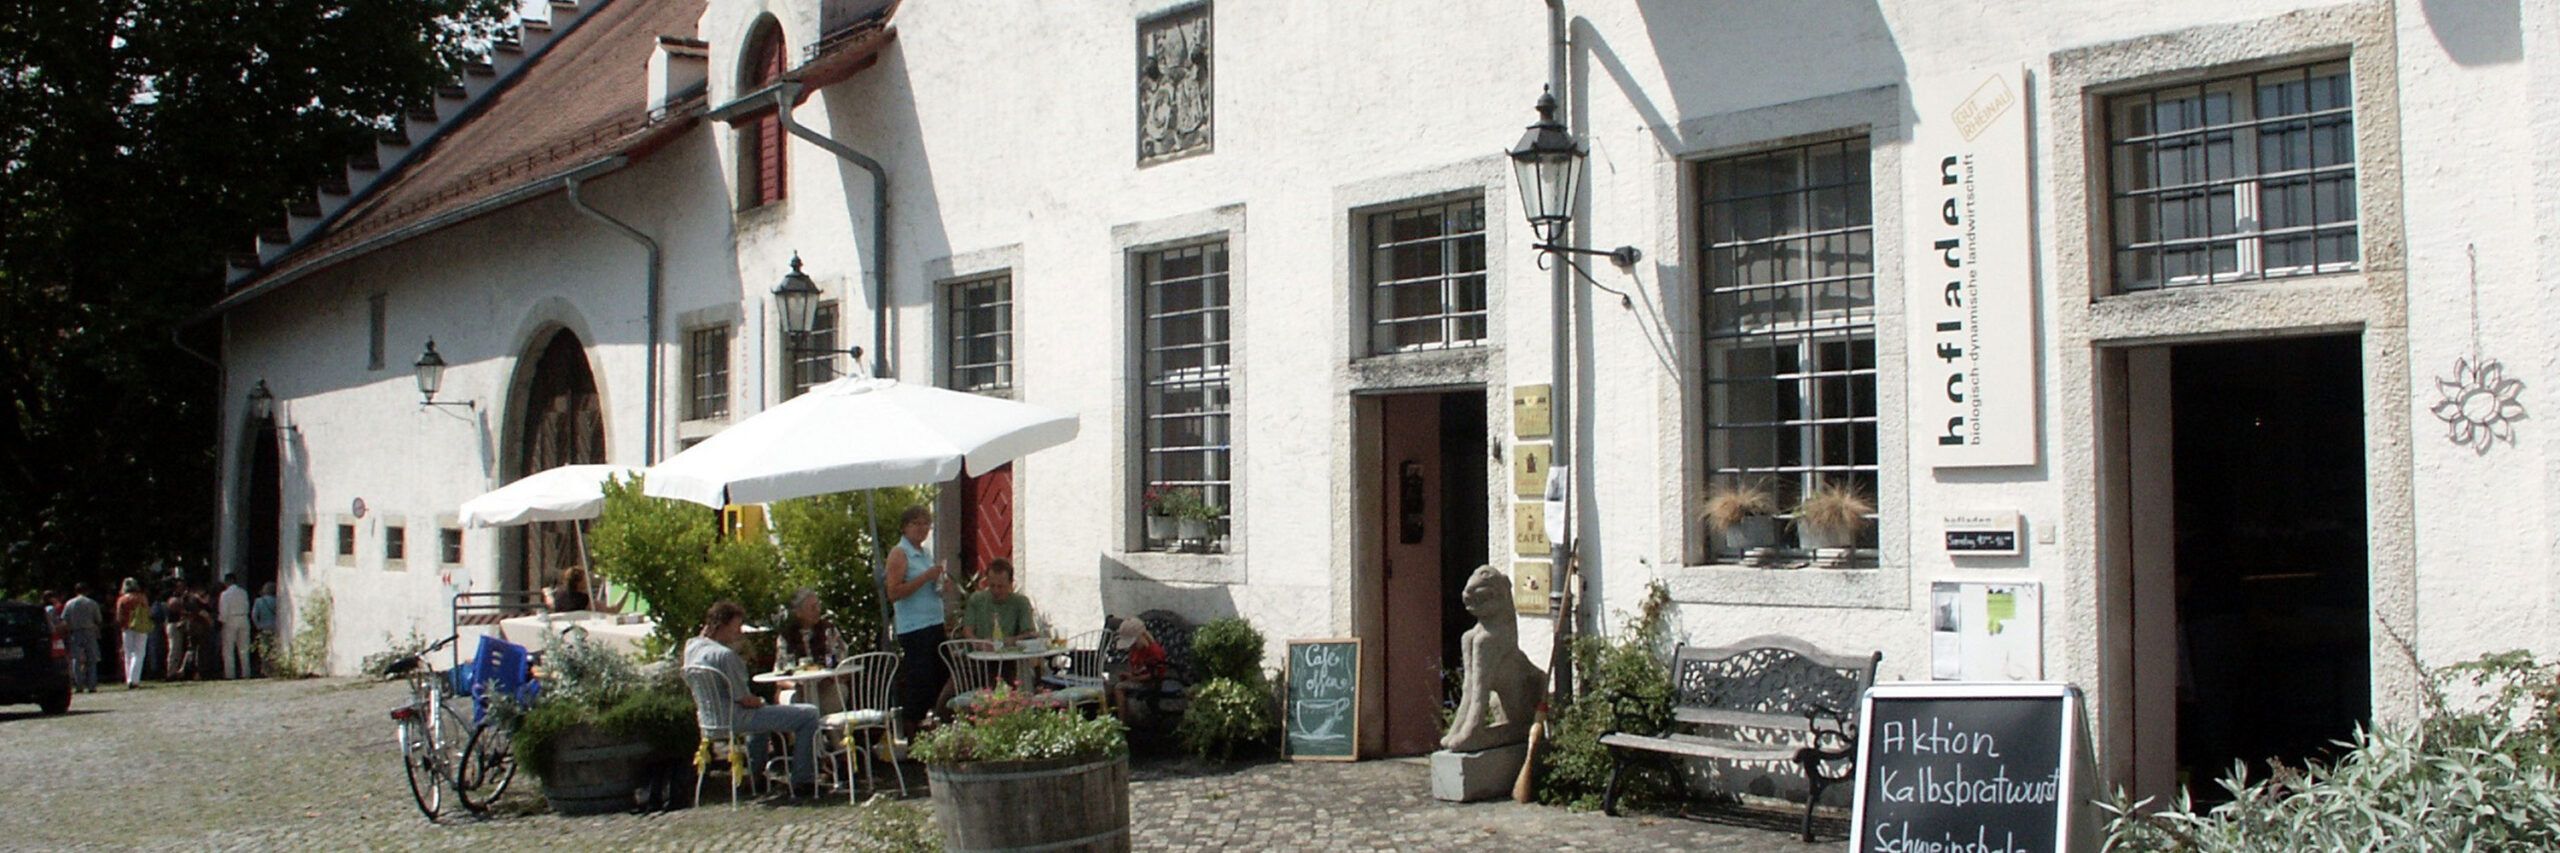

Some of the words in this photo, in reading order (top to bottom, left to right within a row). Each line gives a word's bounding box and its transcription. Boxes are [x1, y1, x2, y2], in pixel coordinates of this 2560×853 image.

[1963, 152, 1978, 266] landwirtschaft
[1934, 154, 1965, 447] hofladen
[1968, 269, 1982, 447] biologisch-dynamische
[1880, 762, 2061, 808] Kalbsbratwurst
[1883, 716, 2000, 758] Aktion
